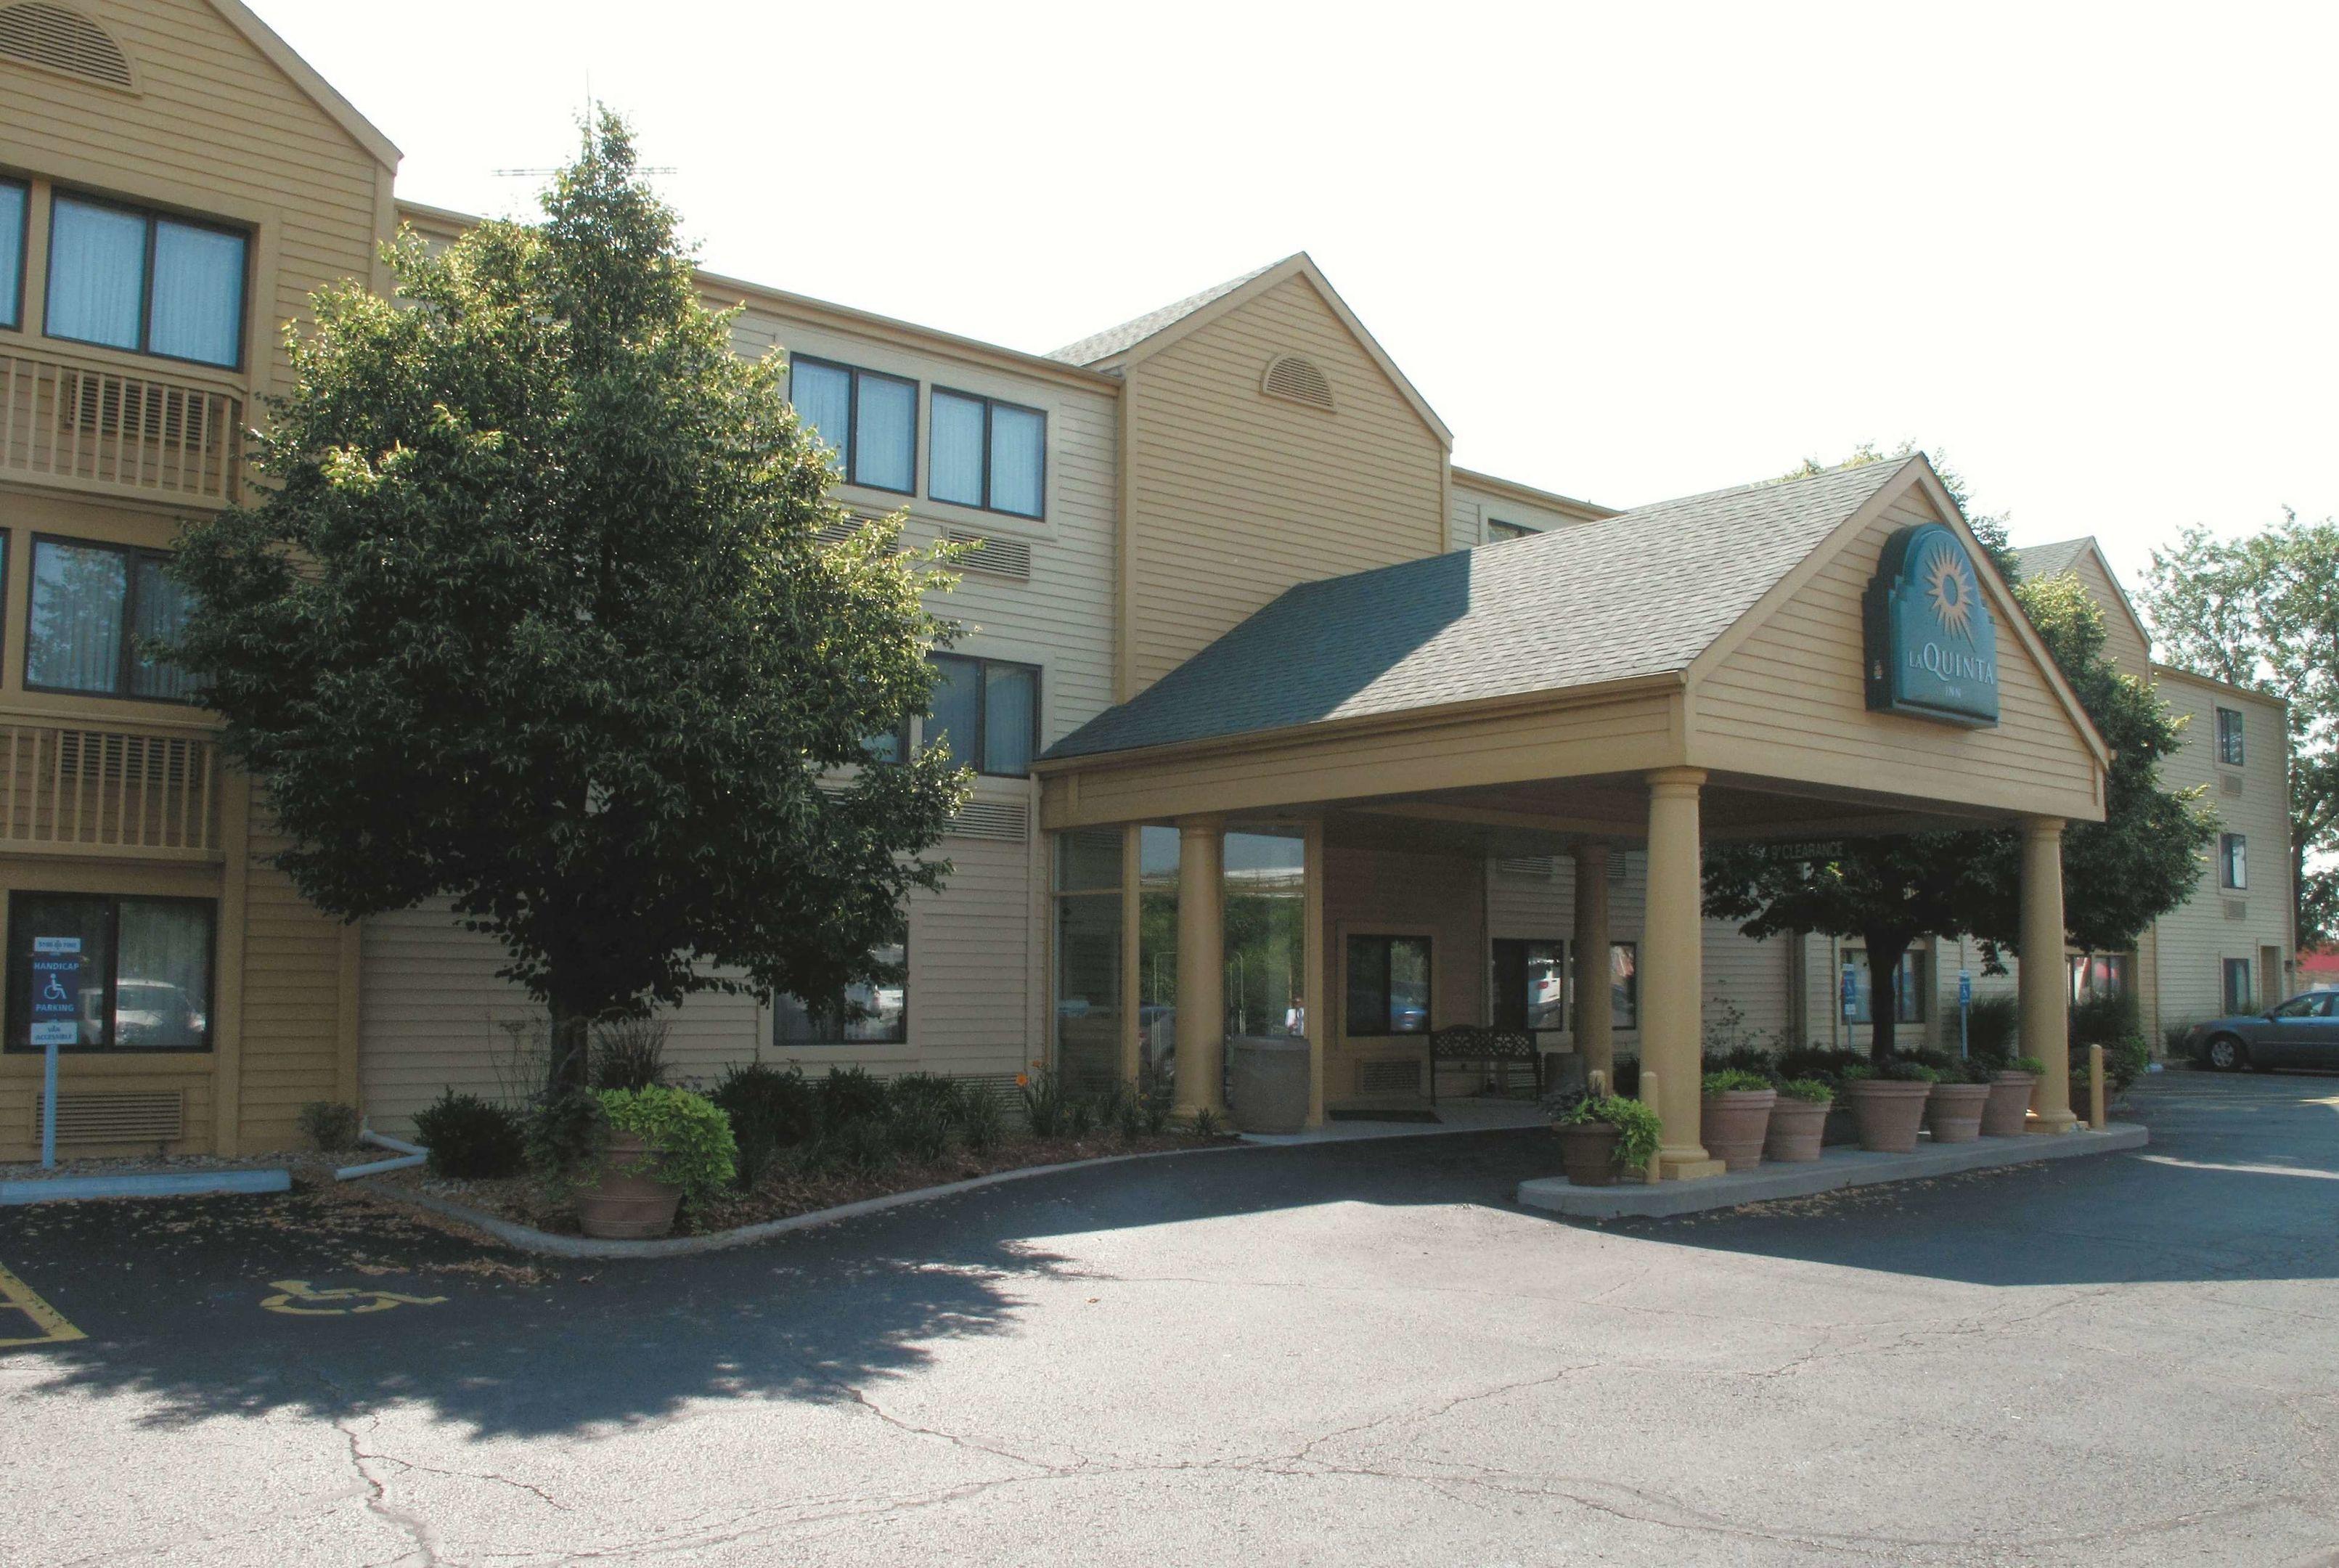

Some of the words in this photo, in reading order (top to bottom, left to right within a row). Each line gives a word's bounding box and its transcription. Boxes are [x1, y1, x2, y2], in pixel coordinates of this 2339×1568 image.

[1909, 650, 1922, 669] LA
[1923, 642, 1993, 685] QUINTA
[1946, 686, 1962, 698] INN
[1781, 841, 1844, 859] CLEARANCE
[34, 962, 79, 971] HANDICAP
